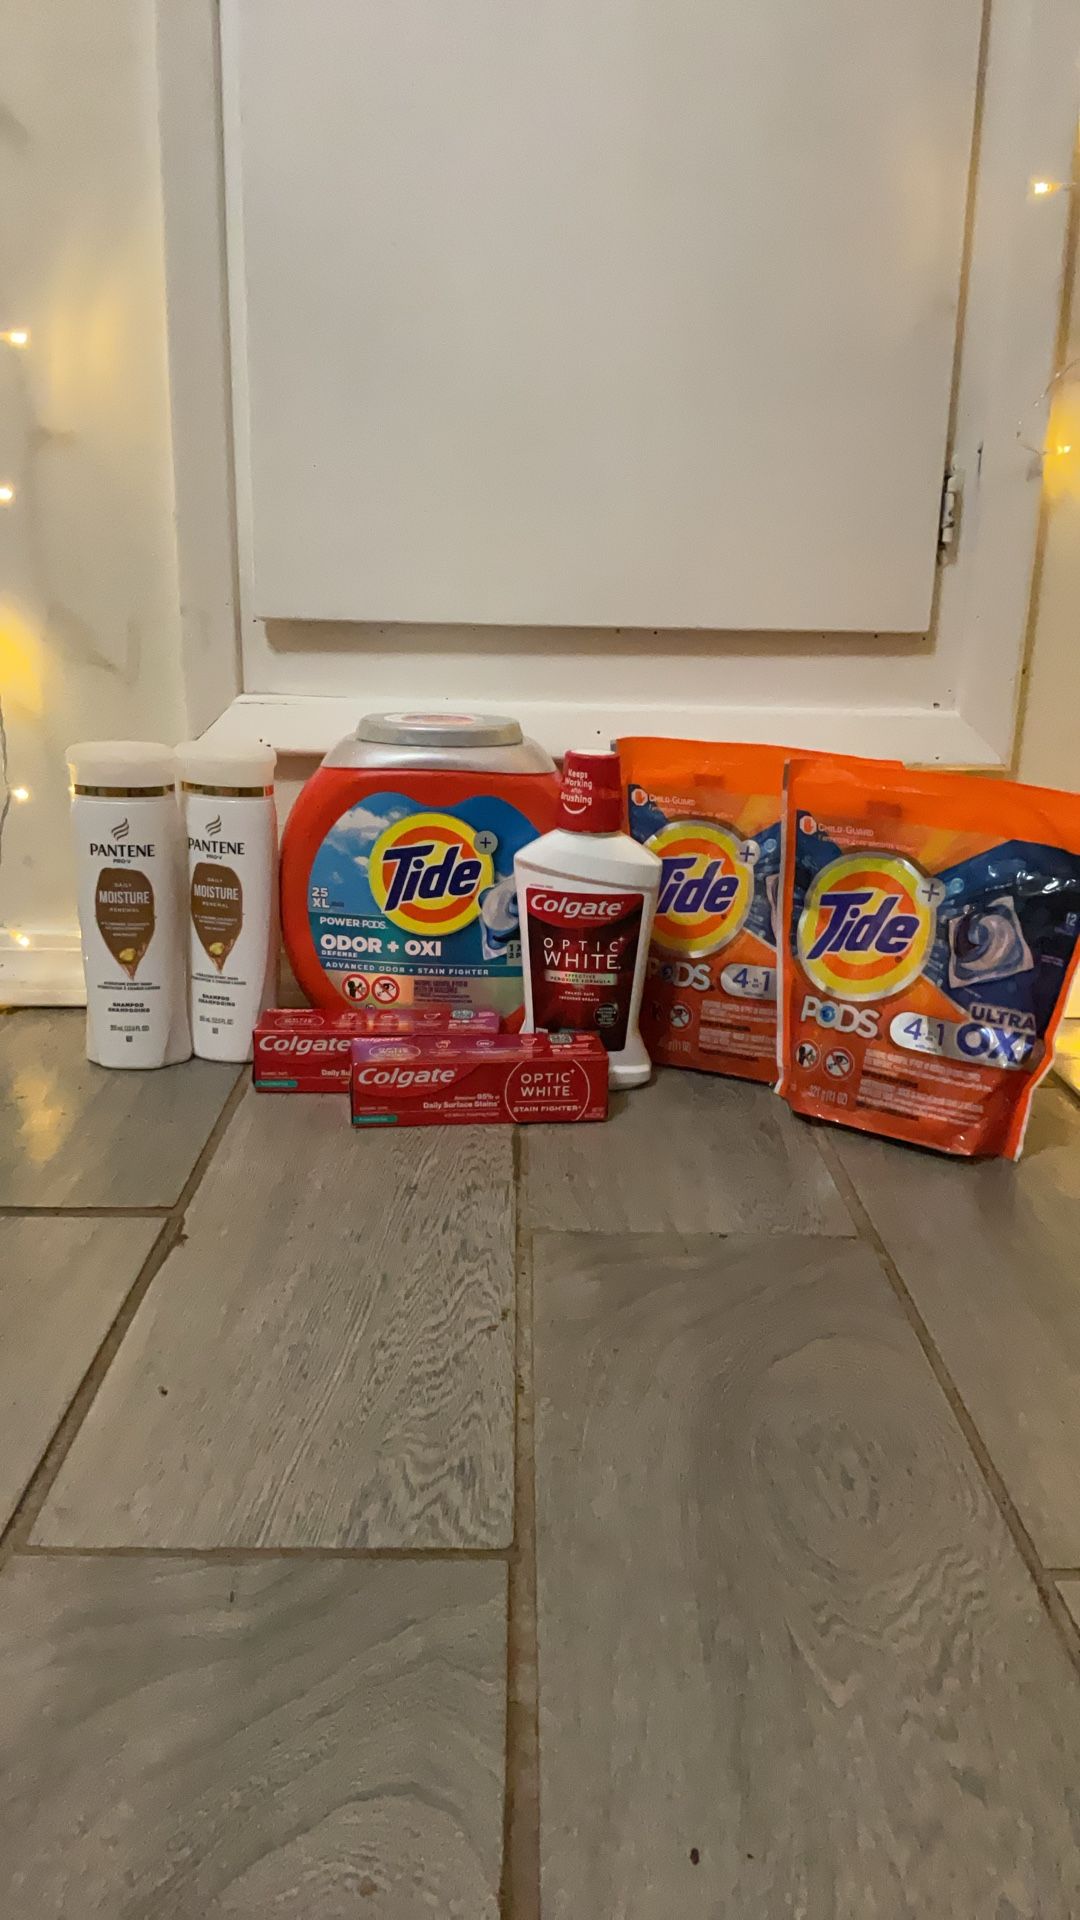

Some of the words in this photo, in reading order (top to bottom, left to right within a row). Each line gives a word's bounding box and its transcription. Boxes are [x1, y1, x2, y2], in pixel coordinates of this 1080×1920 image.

[567, 769, 588, 779] Keeps
[565, 779, 593, 789] Working
[561, 793, 592, 806] Brushing
[89, 843, 155, 857] PANTENE
[188, 837, 245, 855] PANTENE
[382, 843, 482, 912] Tide
[98, 890, 150, 904] MOISTURE
[193, 884, 239, 900] MOISTURE
[312, 887, 328, 897] 25
[312, 898, 330, 908] XL
[530, 894, 622, 919] Colgate
[320, 916, 359, 928] POWER
[806, 892, 921, 960] Tide
[320, 934, 382, 953] ODOR
[404, 940, 442, 957] OXI
[543, 937, 619, 952] OPTIC
[543, 950, 619, 970] WHITE
[326, 961, 375, 972] ADVANCED
[417, 968, 445, 976] STAIN
[800, 995, 881, 1039] PODS
[971, 1004, 1035, 1030] ULTRA
[259, 1035, 350, 1056] Colgate
[358, 1068, 456, 1088] Colgate
[521, 1072, 571, 1084] OPTIC
[521, 1085, 571, 1097] WHITE
[423, 1101, 442, 1110] Daily
[443, 1101, 472, 1109] Surface
